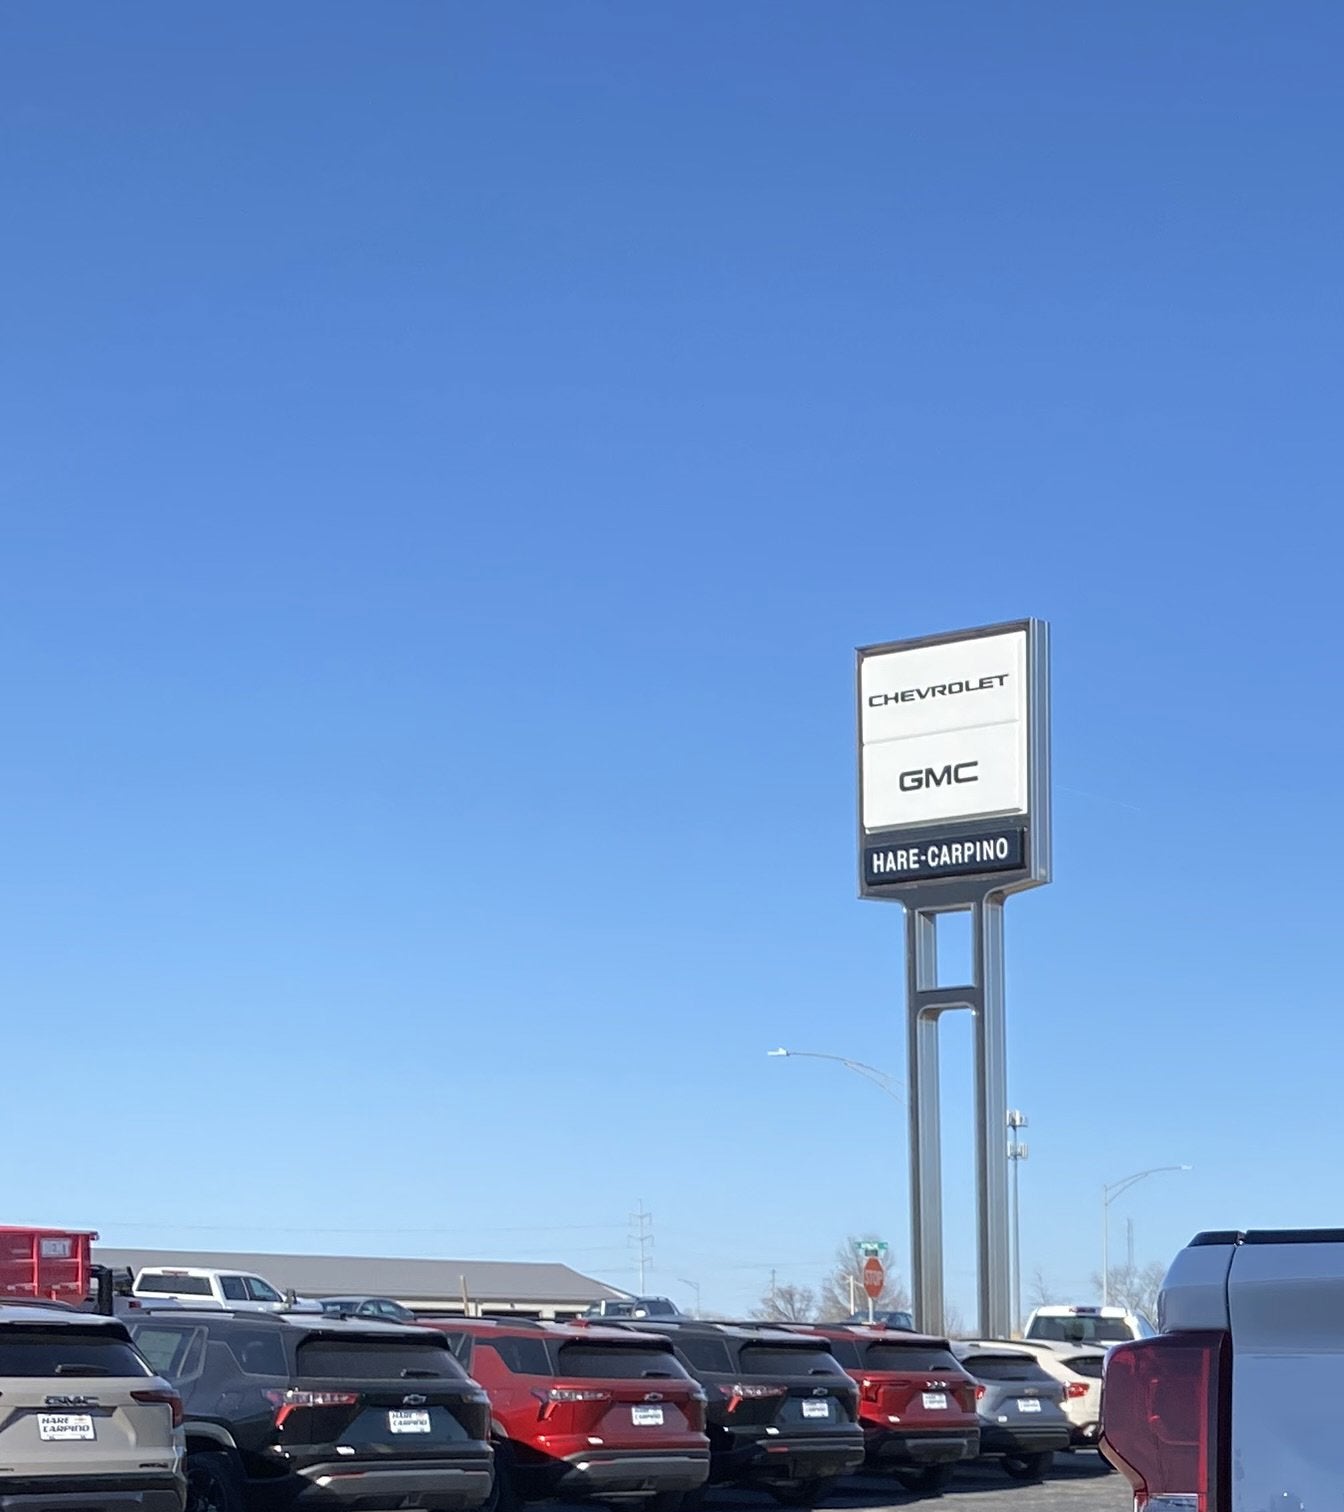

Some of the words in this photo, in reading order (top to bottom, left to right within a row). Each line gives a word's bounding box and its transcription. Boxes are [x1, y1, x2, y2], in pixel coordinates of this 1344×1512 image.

[868, 673, 1010, 708] CHEVROLET
[898, 760, 979, 792] GMC
[872, 836, 1009, 874] HARE-CARPINO
[864, 1270, 883, 1286] STOP
[43, 1424, 90, 1433] CARPINO
